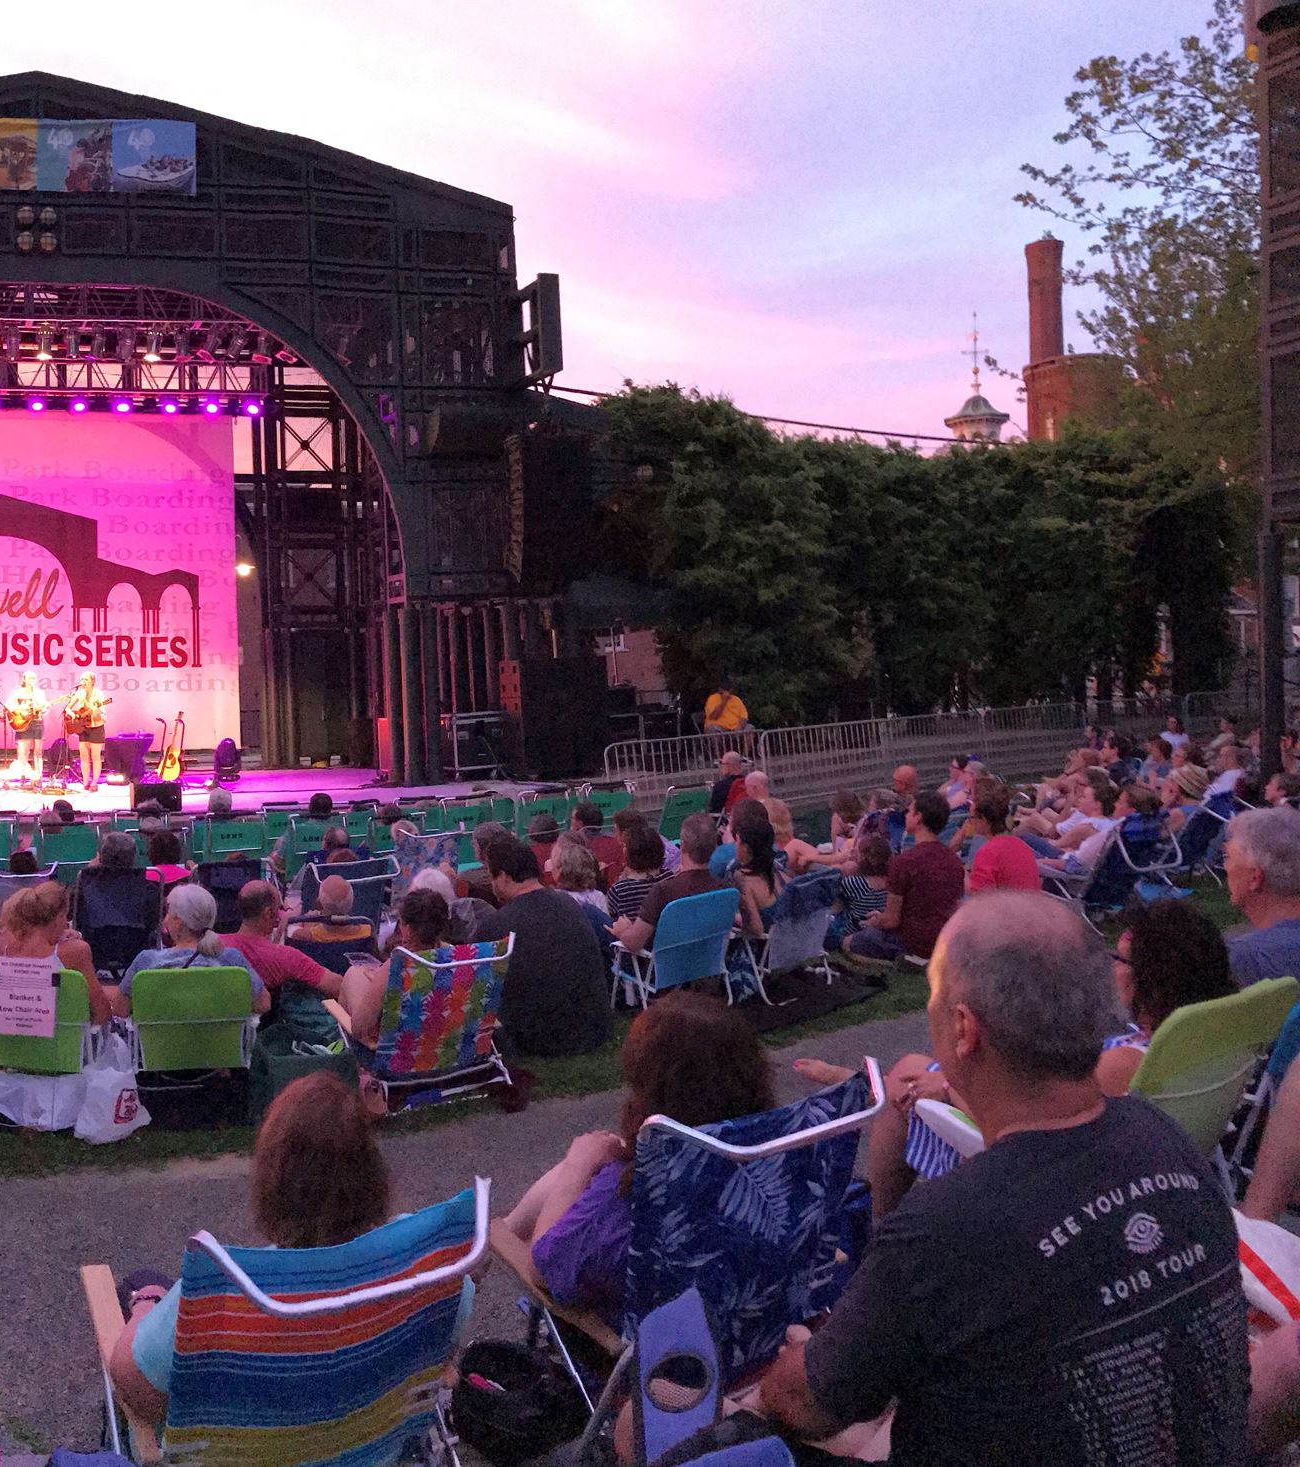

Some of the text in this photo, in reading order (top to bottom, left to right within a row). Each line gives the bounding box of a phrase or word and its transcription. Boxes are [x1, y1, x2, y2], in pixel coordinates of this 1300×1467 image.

[73, 634, 189, 668] SERIES
[9, 993, 34, 1001] Blanket
[15, 1005, 33, 1013] Chair
[34, 1007, 50, 1015] Area
[1038, 1171, 1200, 1258] SEE YOU AROUND
[1101, 1243, 1207, 1307] 2018 TOUR
